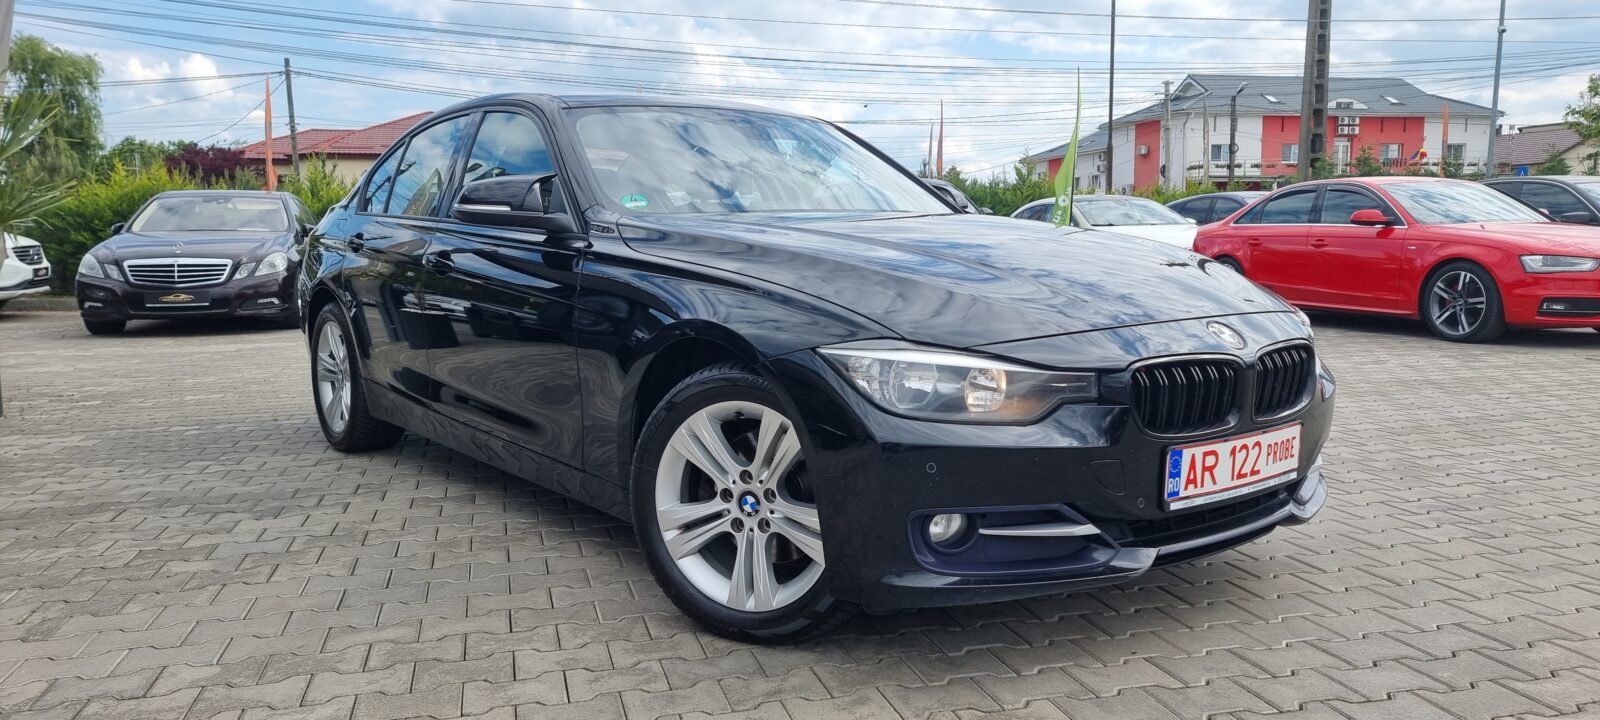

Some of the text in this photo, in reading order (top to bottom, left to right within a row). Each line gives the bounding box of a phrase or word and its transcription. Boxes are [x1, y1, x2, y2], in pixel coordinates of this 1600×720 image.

[1184, 450, 1219, 491] AR
[1229, 441, 1262, 481] 122
[1266, 436, 1296, 466] PROBE
[1168, 478, 1179, 493] RO
